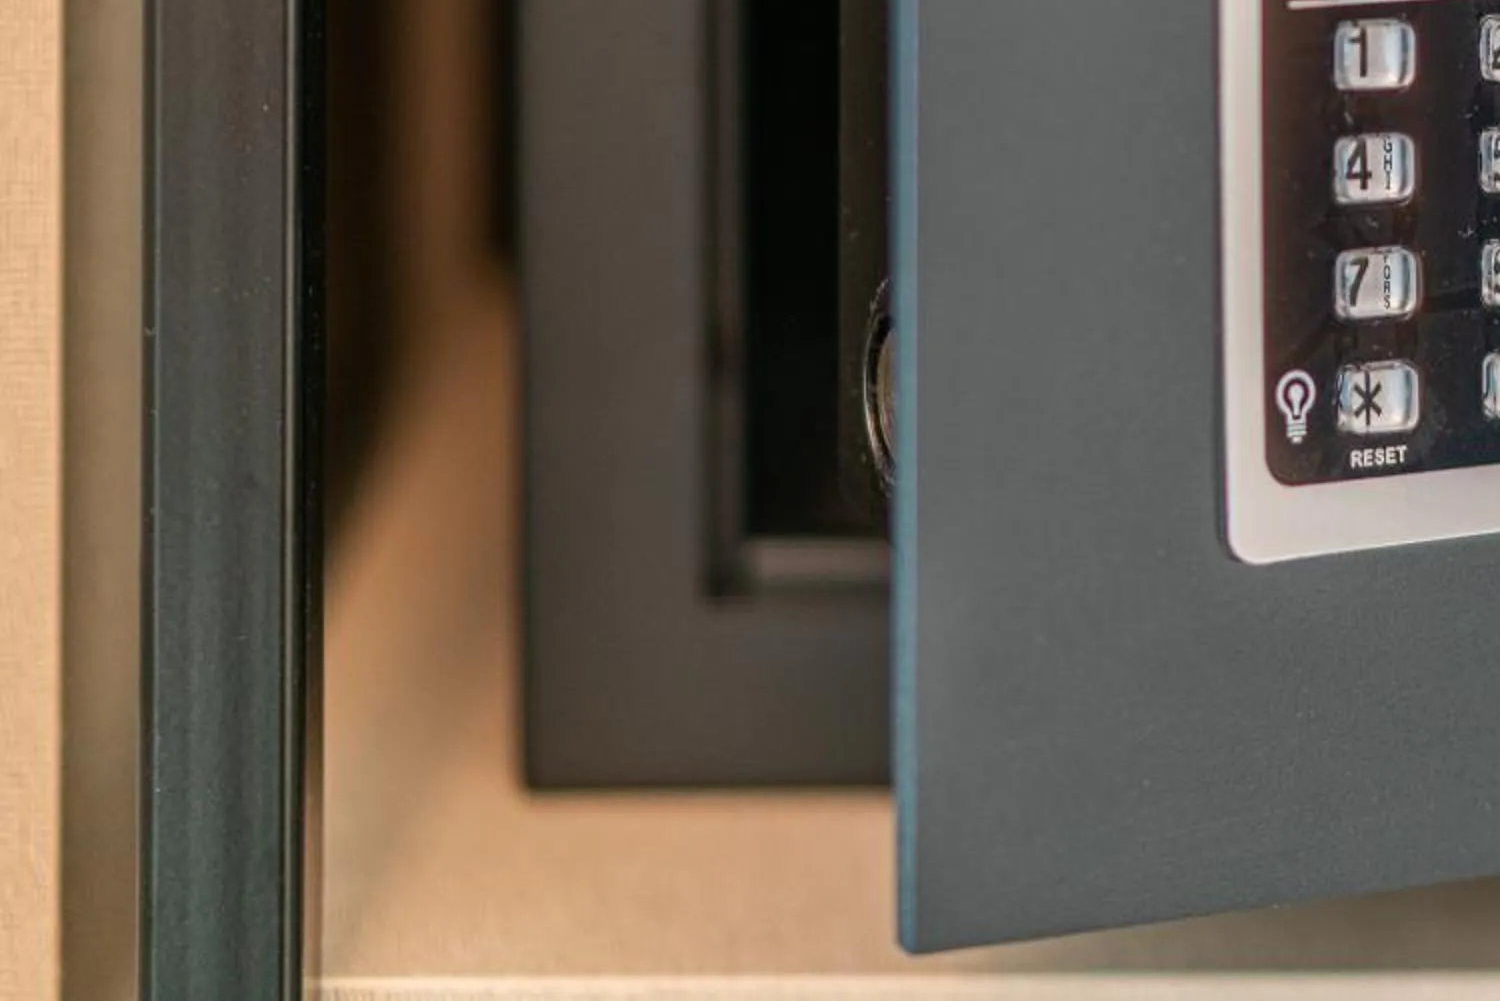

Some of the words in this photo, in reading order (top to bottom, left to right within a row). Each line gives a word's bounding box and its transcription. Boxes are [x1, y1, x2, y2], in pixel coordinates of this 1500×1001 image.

[1348, 26, 1367, 78] 1
[1346, 136, 1372, 190] 4
[1348, 255, 1369, 307] 7
[1350, 445, 1408, 469] RESET
